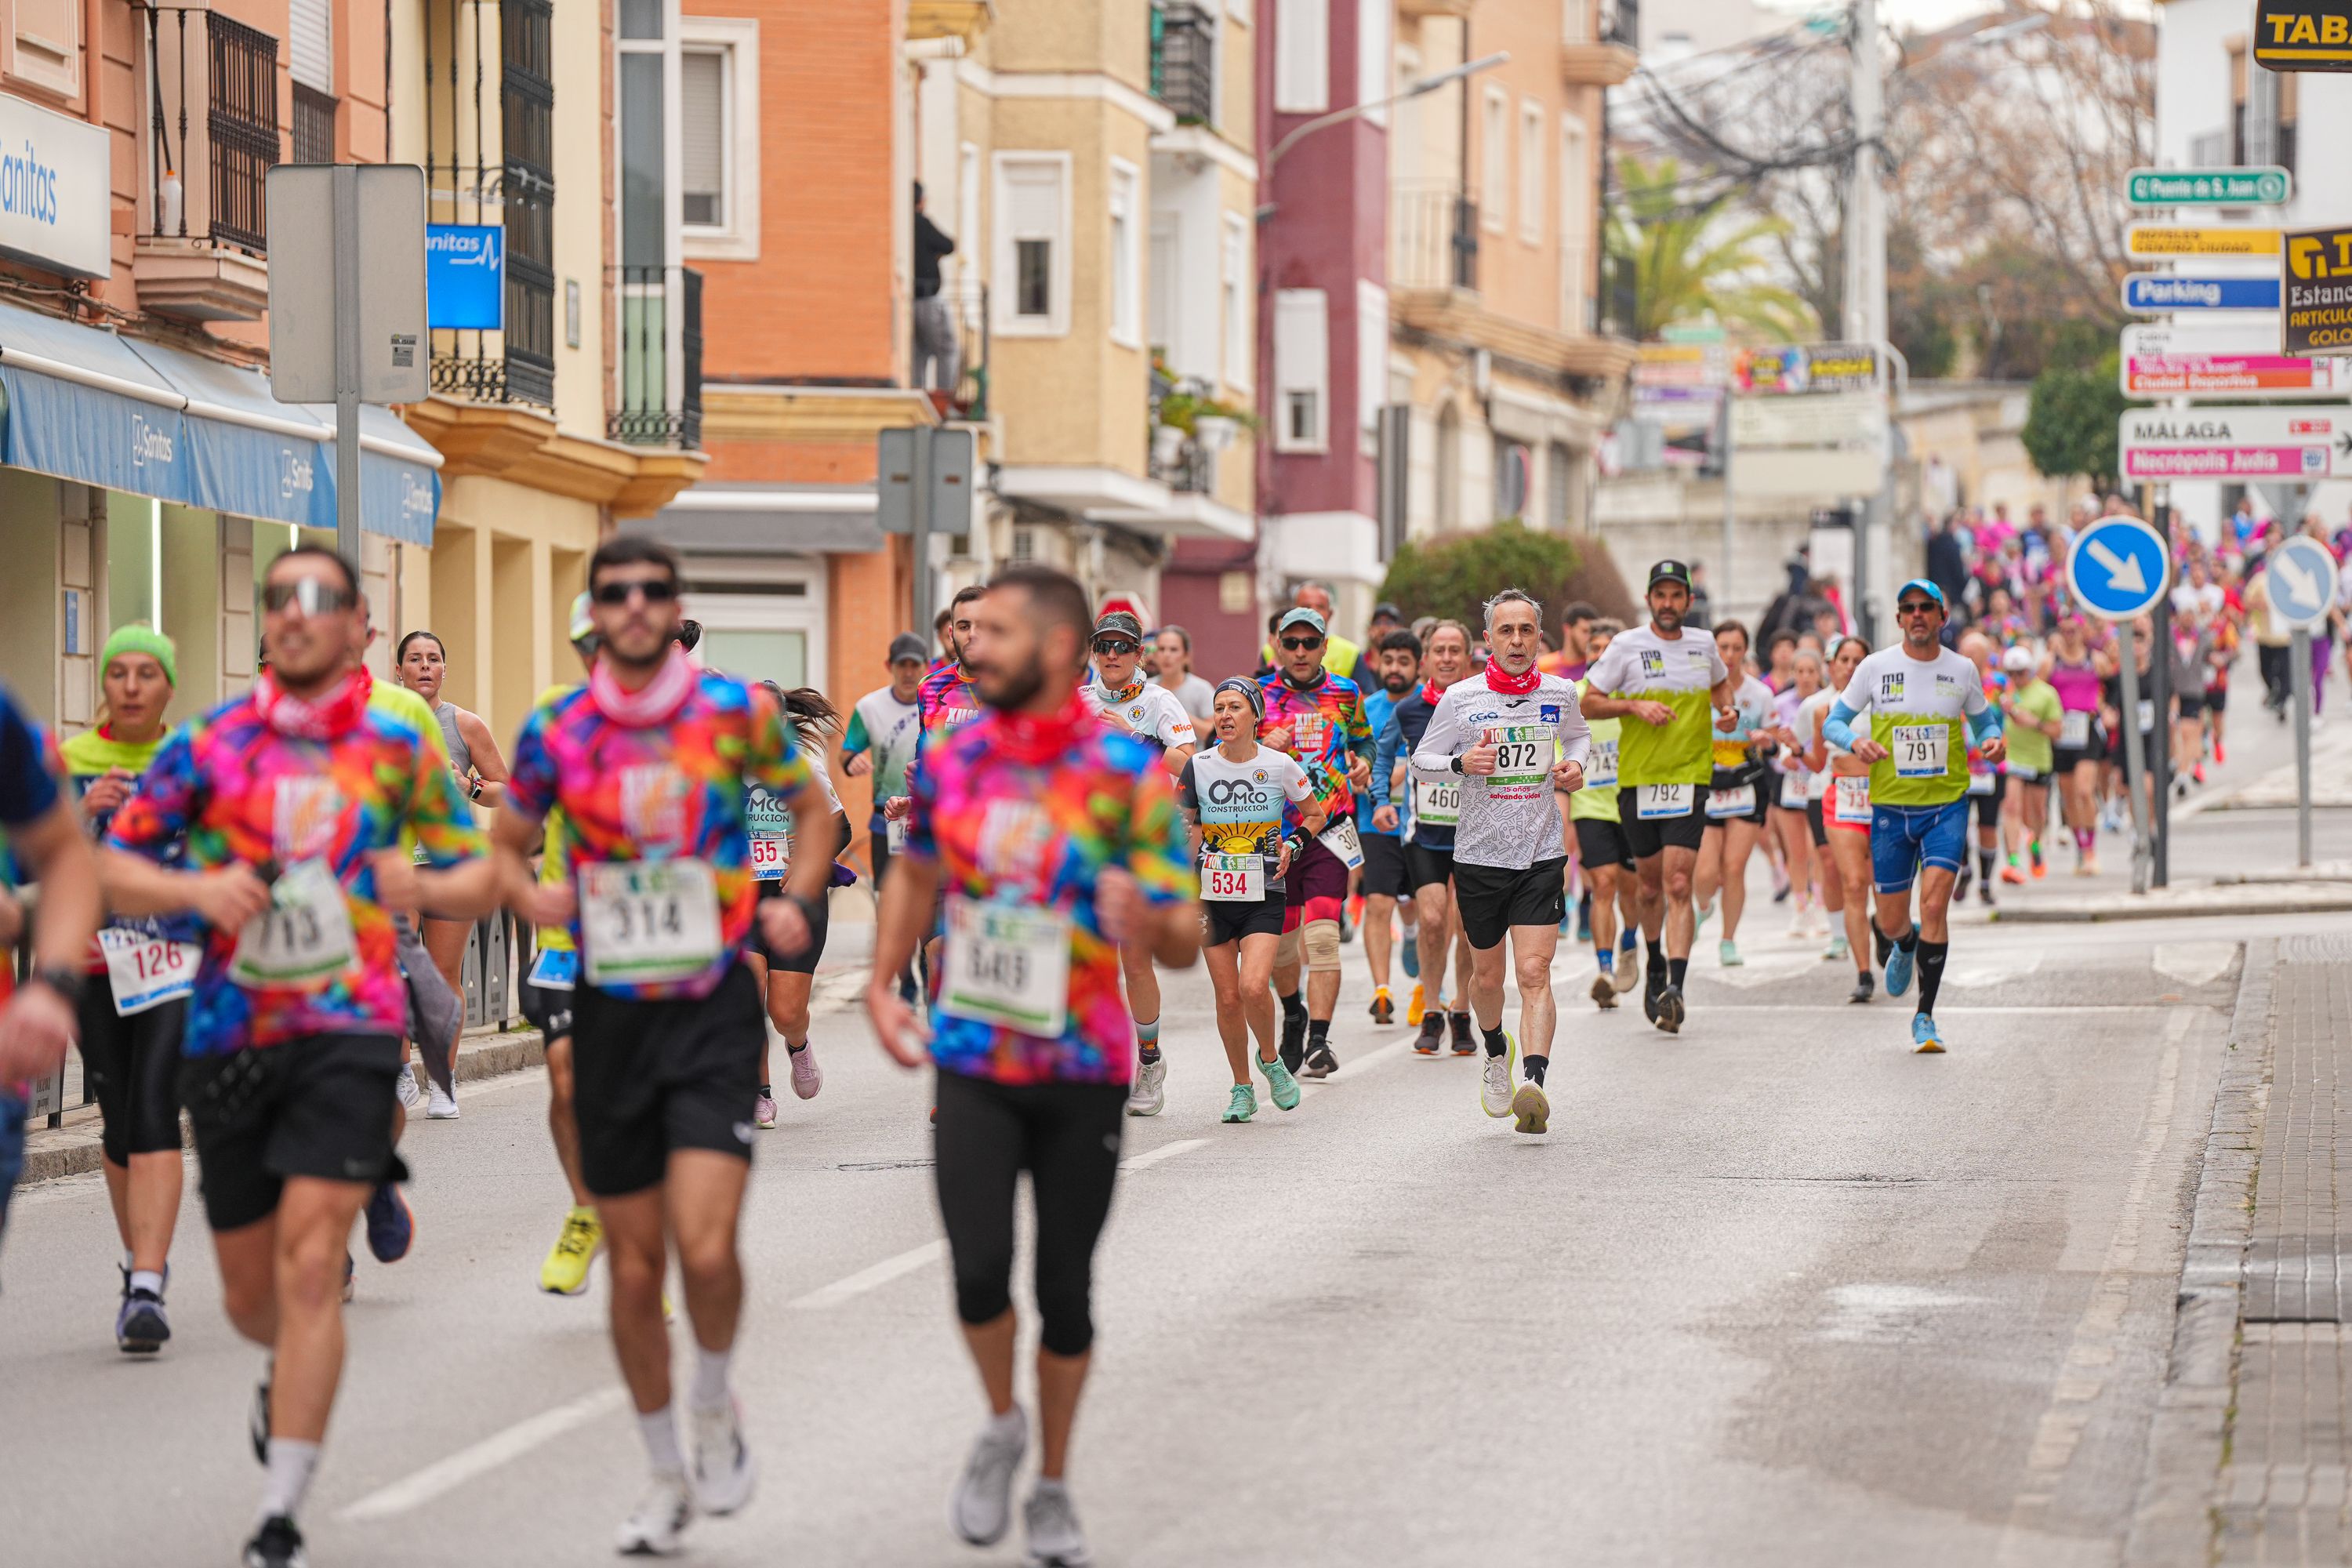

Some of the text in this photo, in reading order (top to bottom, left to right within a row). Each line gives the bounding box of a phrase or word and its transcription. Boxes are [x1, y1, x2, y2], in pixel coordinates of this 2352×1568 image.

[2266, 13, 2352, 45] TAB
[0, 139, 56, 226] anitas
[2136, 280, 2221, 307] Parking
[2134, 416, 2231, 440] MÁLAGA
[1541, 713, 1557, 722] AXA
[1498, 743, 1537, 768] 872
[1906, 742, 1936, 761] 791
[1428, 789, 1460, 808] 460
[1650, 783, 1680, 802] 792
[1207, 804, 1269, 813] CONSTRUCCION
[1212, 872, 1247, 895] 534
[611, 898, 682, 941] 314
[133, 940, 183, 980] 126
